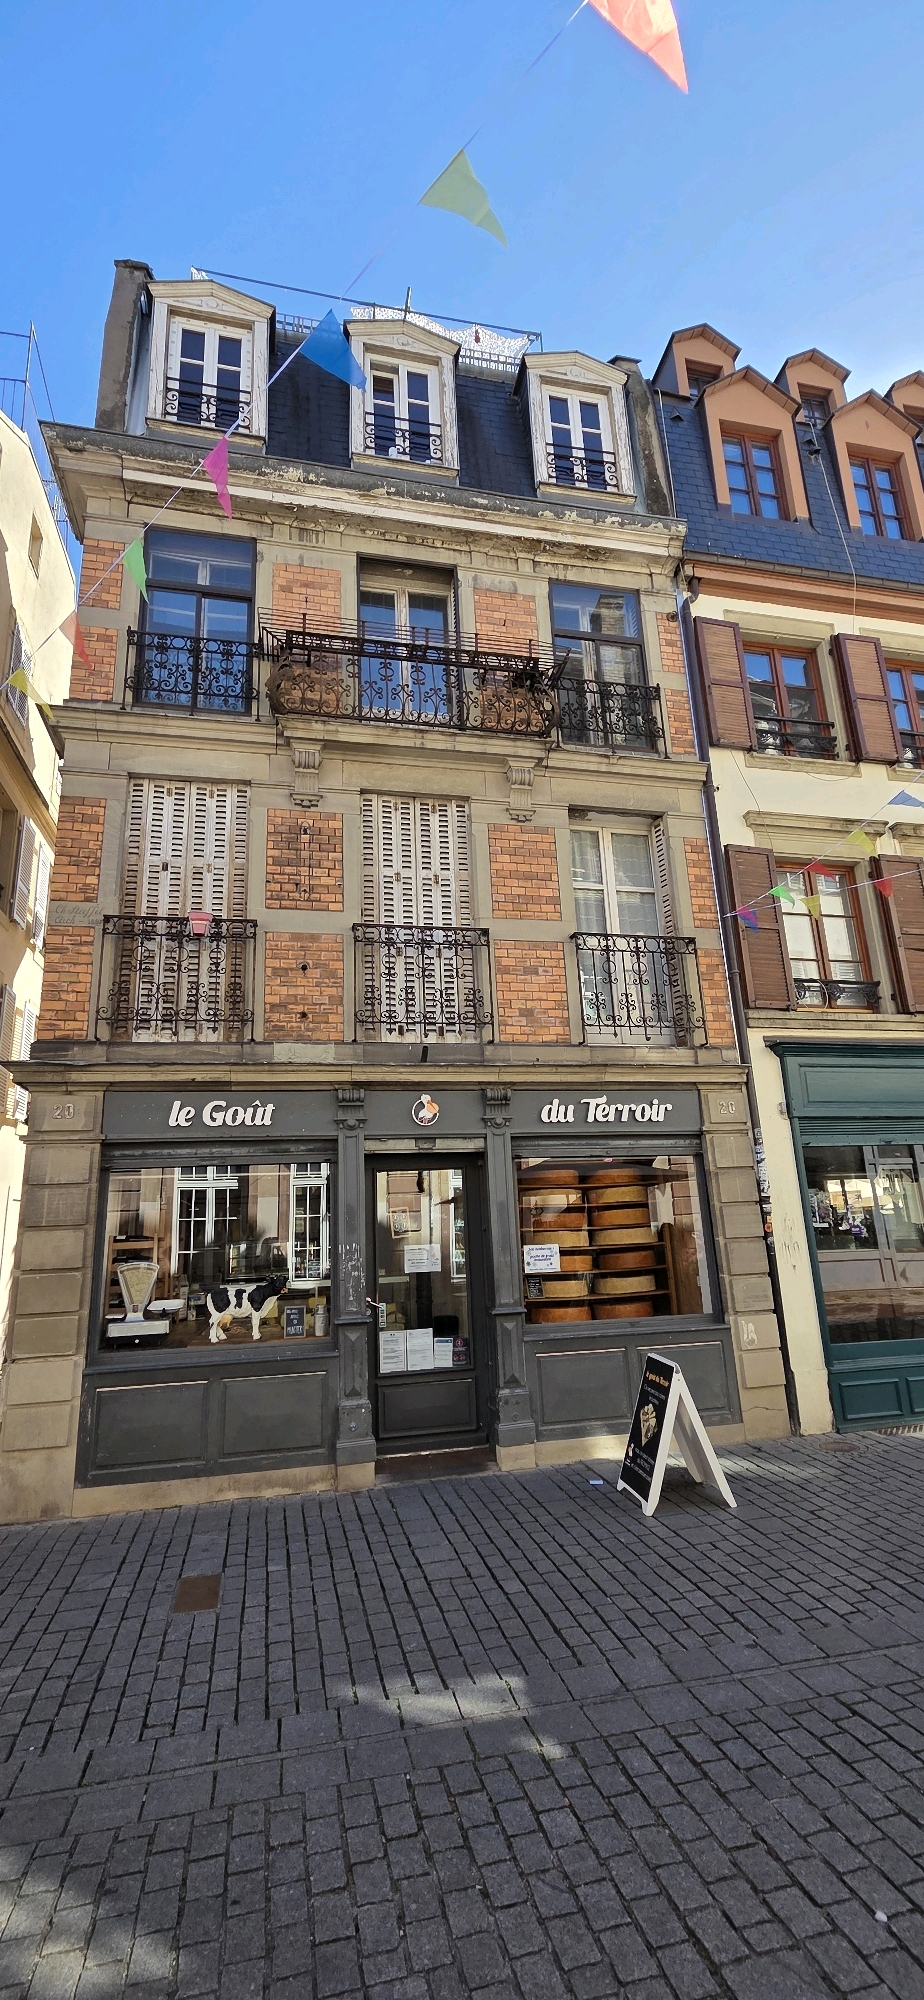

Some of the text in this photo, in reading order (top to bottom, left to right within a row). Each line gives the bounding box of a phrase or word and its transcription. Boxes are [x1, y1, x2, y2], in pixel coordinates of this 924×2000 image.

[52, 1103, 75, 1119] 20
[168, 1099, 276, 1128] le Goût
[540, 1094, 673, 1123] du Terroir
[718, 1101, 736, 1115] 20
